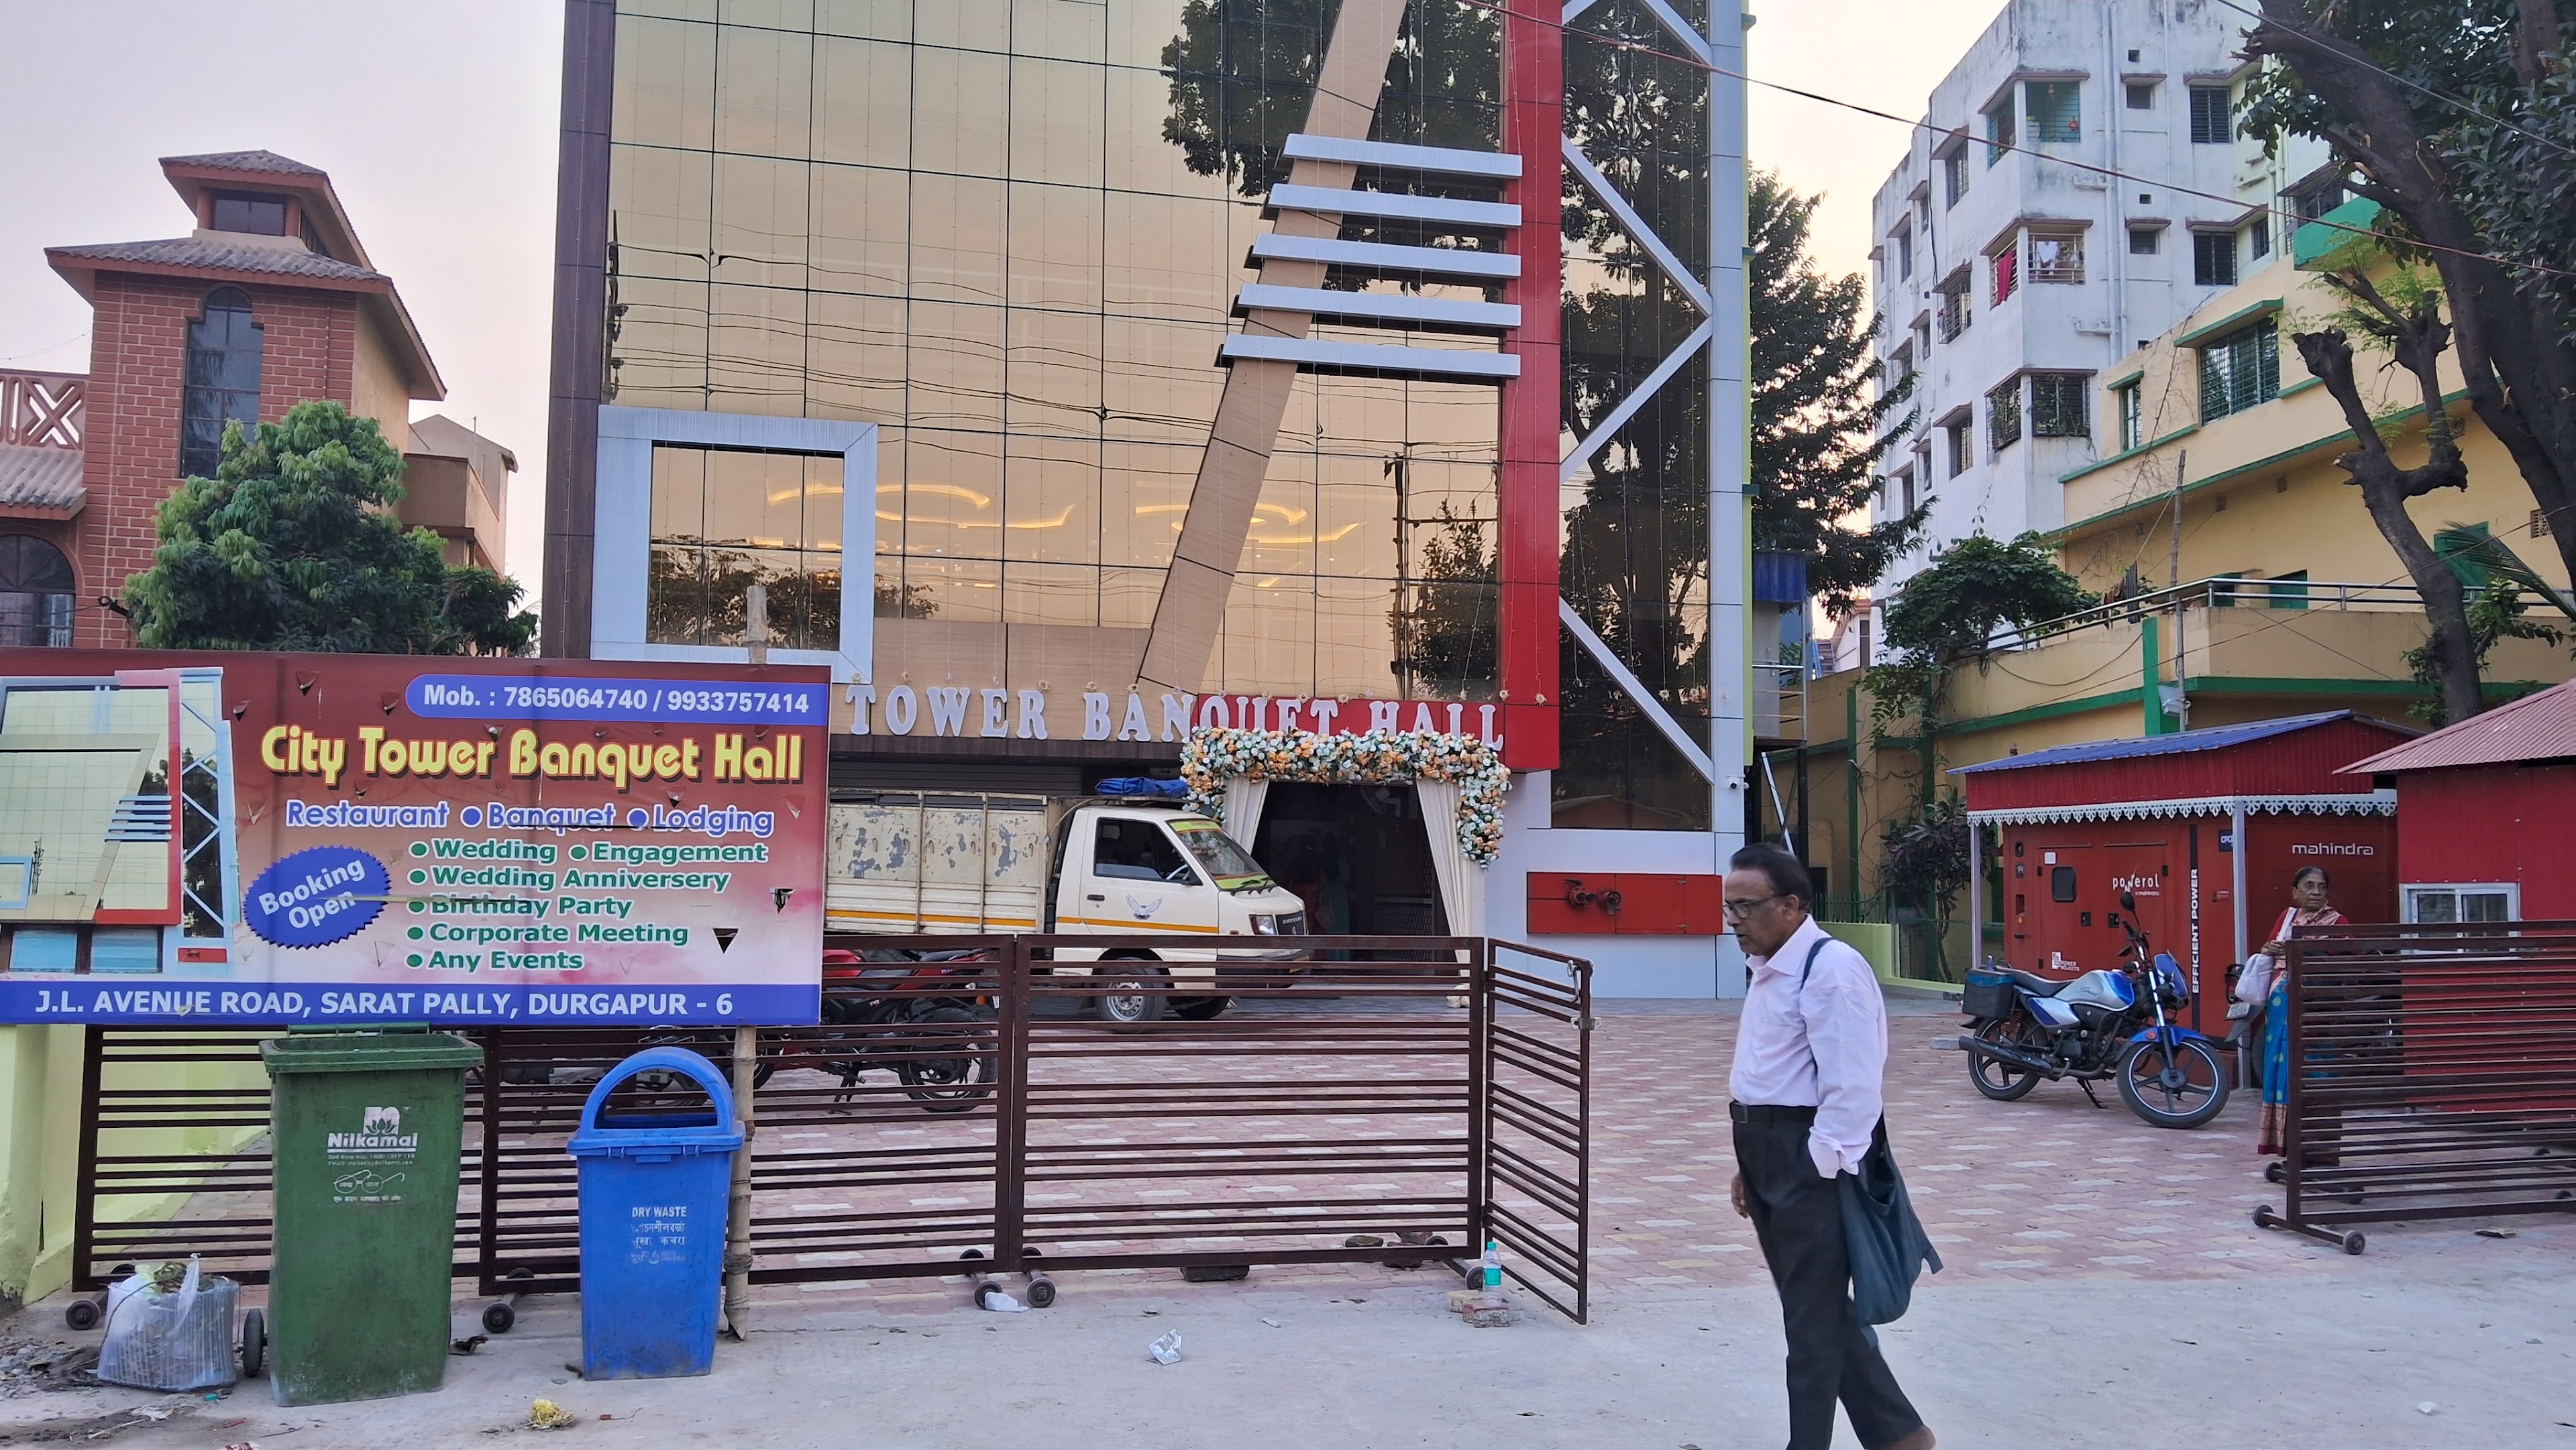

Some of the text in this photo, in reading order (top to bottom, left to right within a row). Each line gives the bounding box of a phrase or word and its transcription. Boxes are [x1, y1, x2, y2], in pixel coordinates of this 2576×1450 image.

[424, 684, 480, 707] Mob.
[504, 686, 647, 710] 7865064740
[667, 690, 808, 713] 9933757414
[845, 684, 1048, 740] TOWER
[262, 726, 801, 788] City Tower Banquet Hall
[286, 801, 773, 835] Restaurant Banquet Lodging
[434, 839, 767, 864] Wedding Engagement
[2292, 843, 2374, 856] mahindra
[258, 859, 366, 915] Booking
[433, 866, 729, 892] Wedding Anniversery
[288, 890, 357, 930] Open
[432, 896, 632, 919] Birthday Party
[430, 923, 688, 945] Corporate Meeting
[428, 951, 582, 972] Any Events
[36, 991, 83, 1013] J.L.
[93, 992, 211, 1013] AVENUE
[221, 993, 311, 1018] ROAD,
[321, 993, 415, 1014] SARAT
[423, 994, 518, 1019] PALLY,
[529, 994, 688, 1015] DURGAPUR
[716, 994, 733, 1015] 6
[327, 1132, 418, 1147] Nilkamal
[632, 1206, 687, 1217] DRY WASTE
